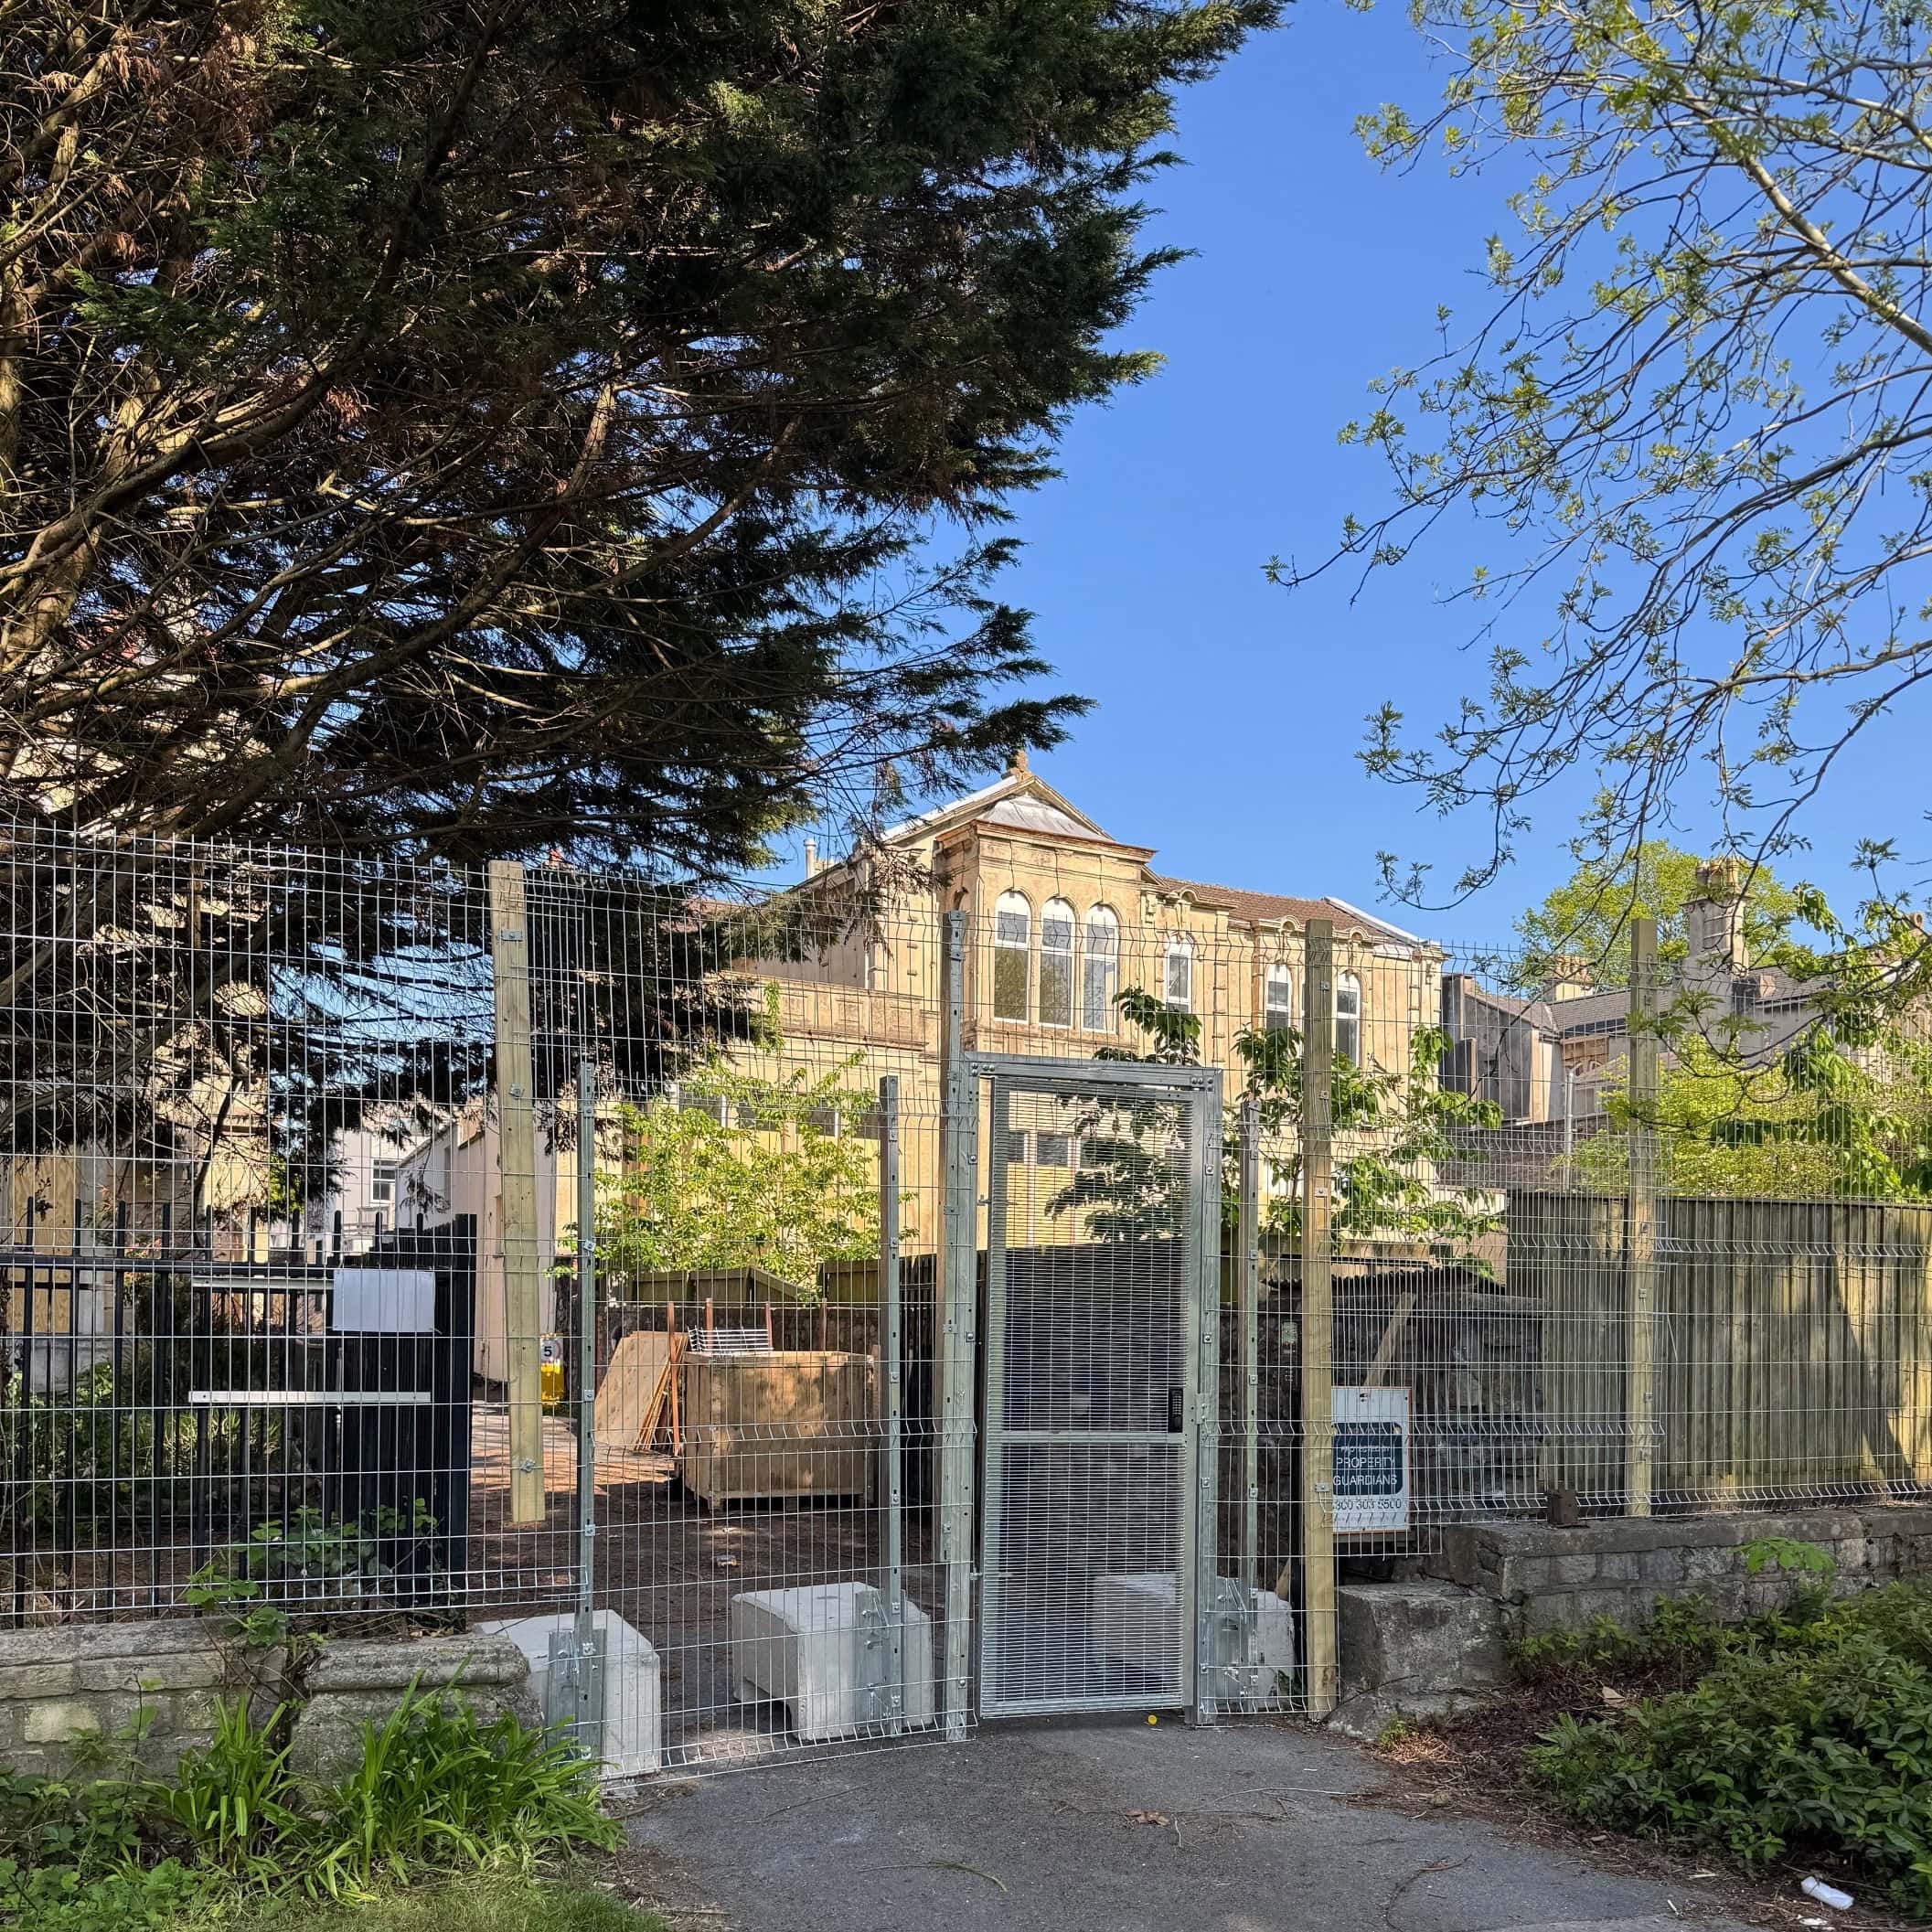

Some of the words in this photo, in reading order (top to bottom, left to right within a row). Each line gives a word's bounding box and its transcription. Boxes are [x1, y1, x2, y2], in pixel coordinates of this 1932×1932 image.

[544, 1346, 552, 1357] 5
[1337, 1457, 1394, 1468] PROPERTY
[1332, 1475, 1398, 1486] GUARDIANS
